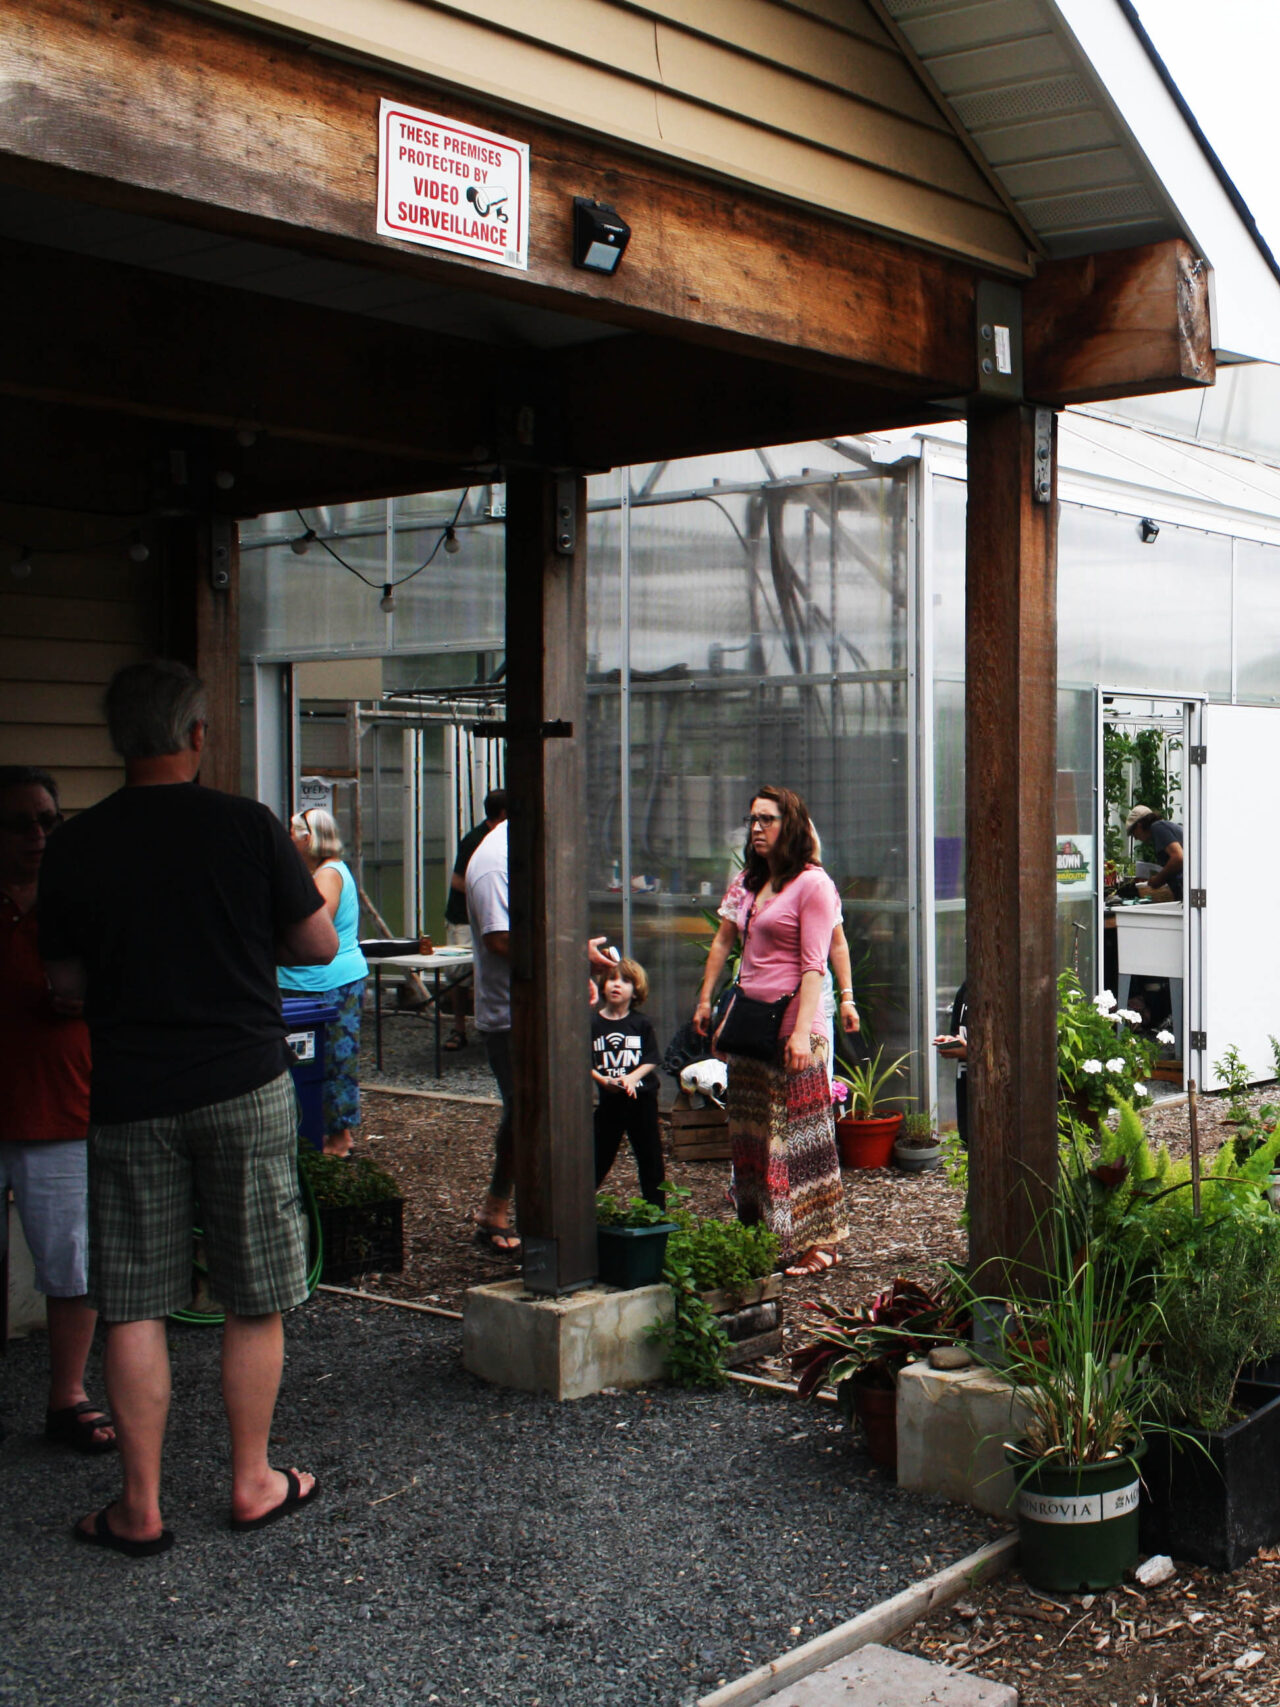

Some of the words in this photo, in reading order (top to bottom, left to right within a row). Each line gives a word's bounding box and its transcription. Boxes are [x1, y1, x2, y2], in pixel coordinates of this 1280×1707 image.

[399, 123, 439, 148] THESE
[443, 136, 502, 167] PREMISES
[399, 146, 470, 179] PROTECTED
[474, 167, 488, 184] BY
[413, 176, 459, 205] VIDEO
[397, 201, 507, 247] SURVEILLANCE
[1056, 854, 1081, 869] ROWN
[606, 1067, 627, 1077] THE
